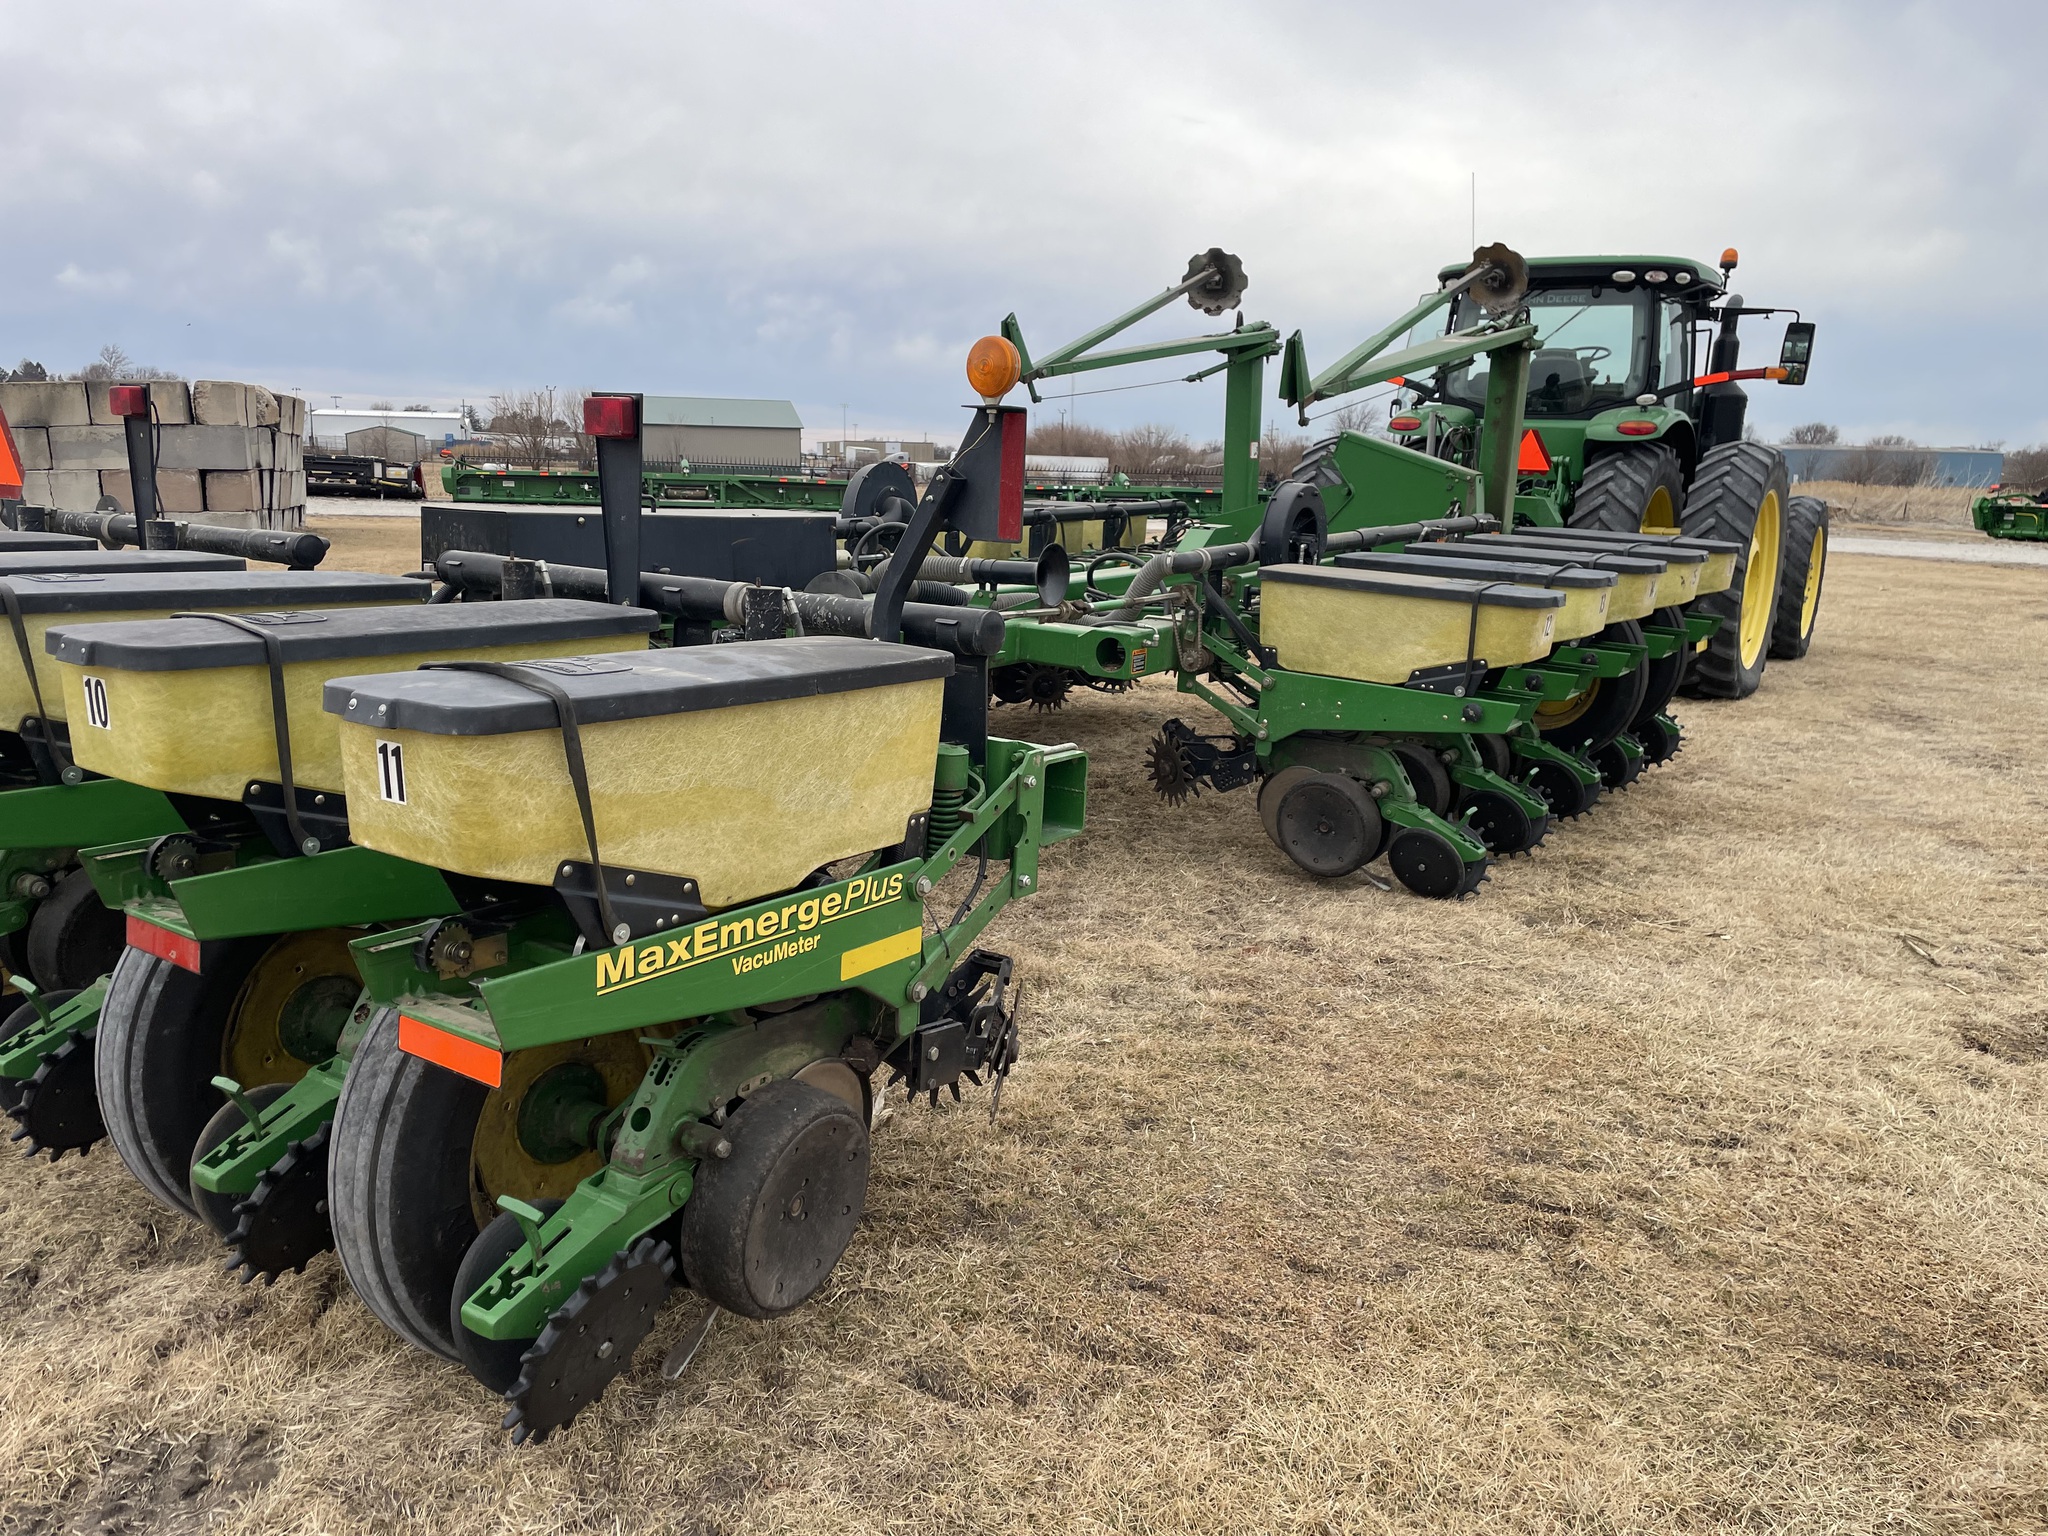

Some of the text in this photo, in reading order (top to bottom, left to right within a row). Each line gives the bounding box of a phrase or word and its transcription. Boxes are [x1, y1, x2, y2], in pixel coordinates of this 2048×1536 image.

[1546, 294, 1587, 304] DEERE
[1544, 614, 1553, 637] 12
[84, 677, 108, 728] 10
[378, 742, 405, 802] 11
[731, 932, 821, 976] VacuMeter
